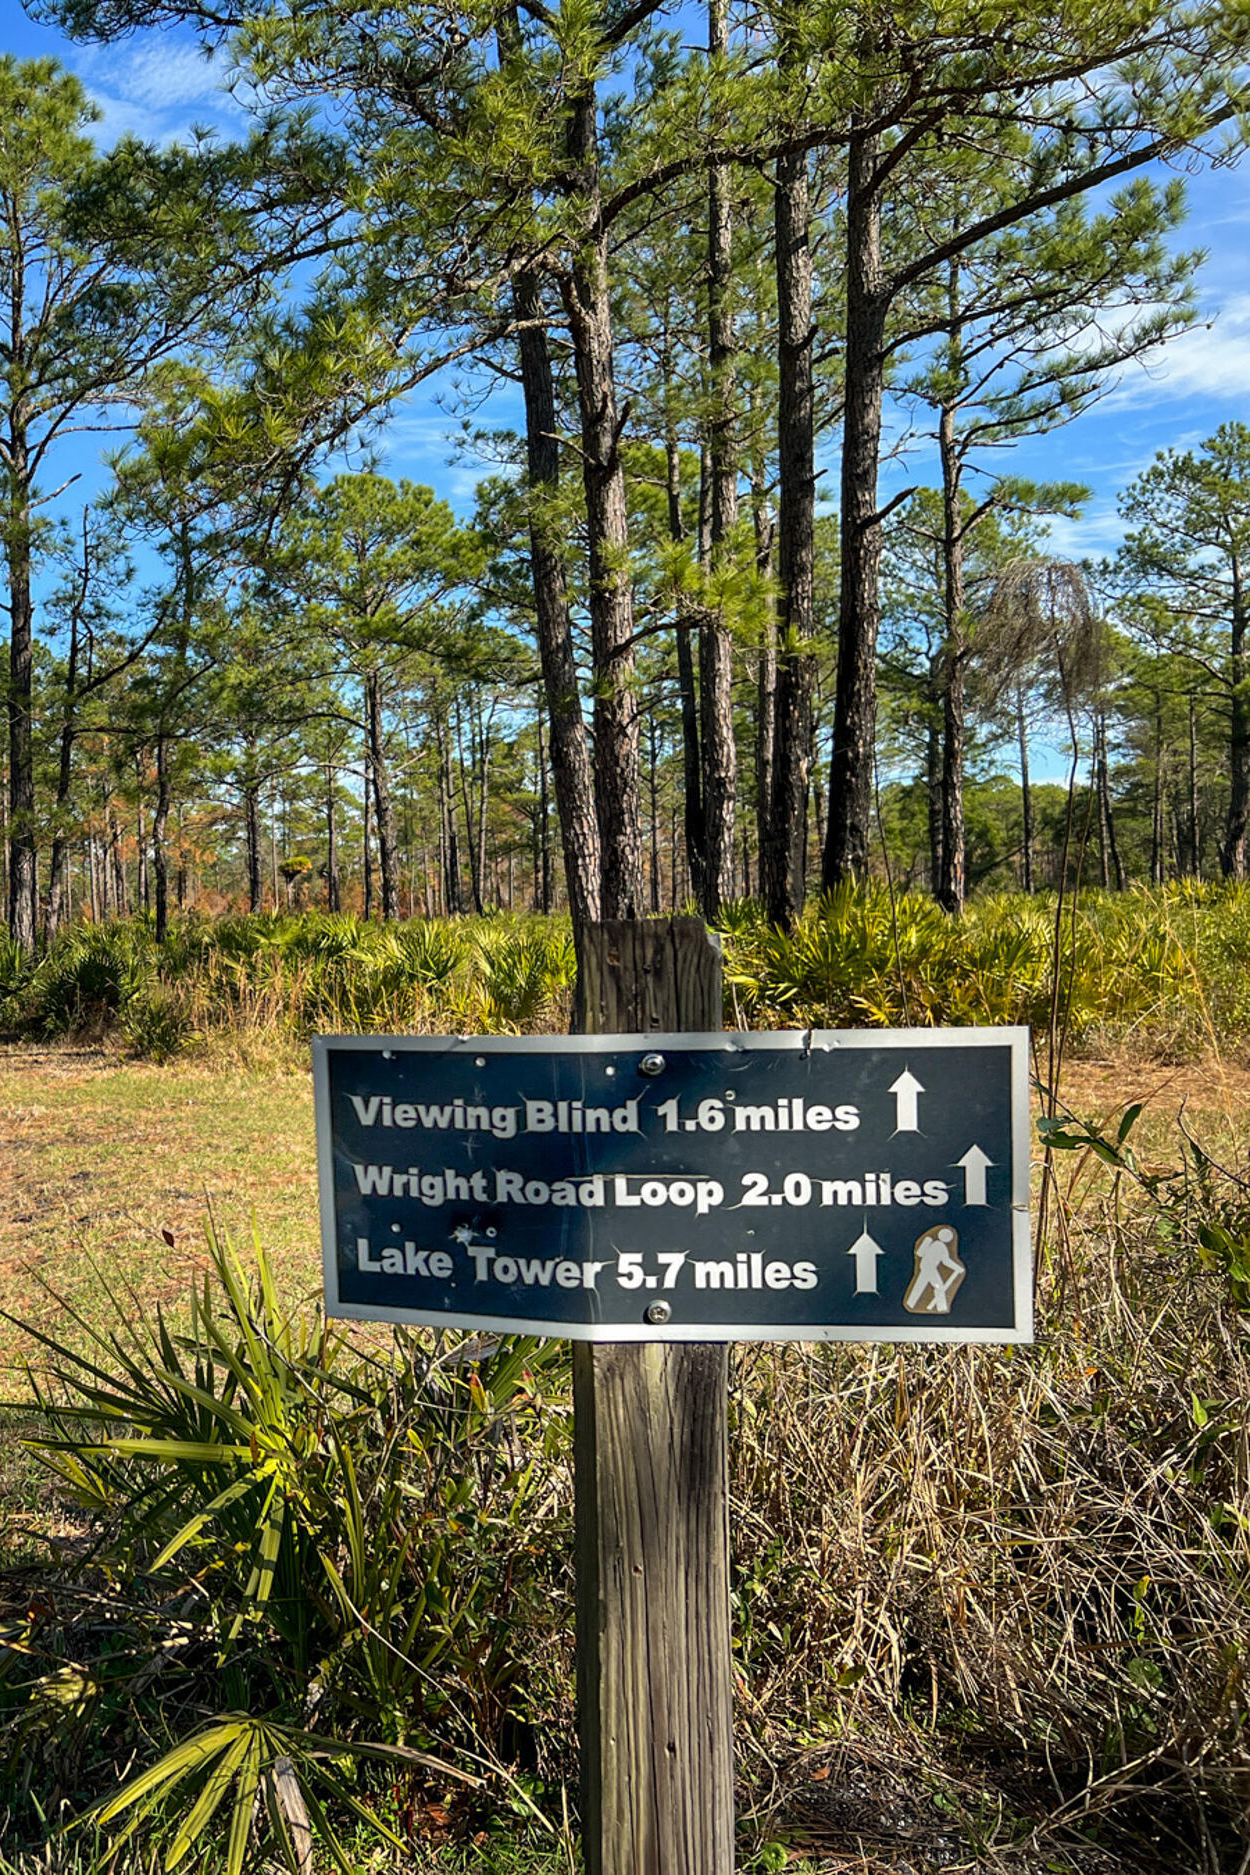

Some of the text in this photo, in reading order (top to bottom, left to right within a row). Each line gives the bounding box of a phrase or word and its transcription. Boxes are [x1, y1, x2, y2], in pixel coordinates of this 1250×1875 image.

[352, 1097, 861, 1136] Viewing Blind 1.6 miles
[354, 1164, 949, 1216] Wright Road Loop 2.0 miles
[357, 1238, 818, 1290] Lake Tower 5.7 miles
